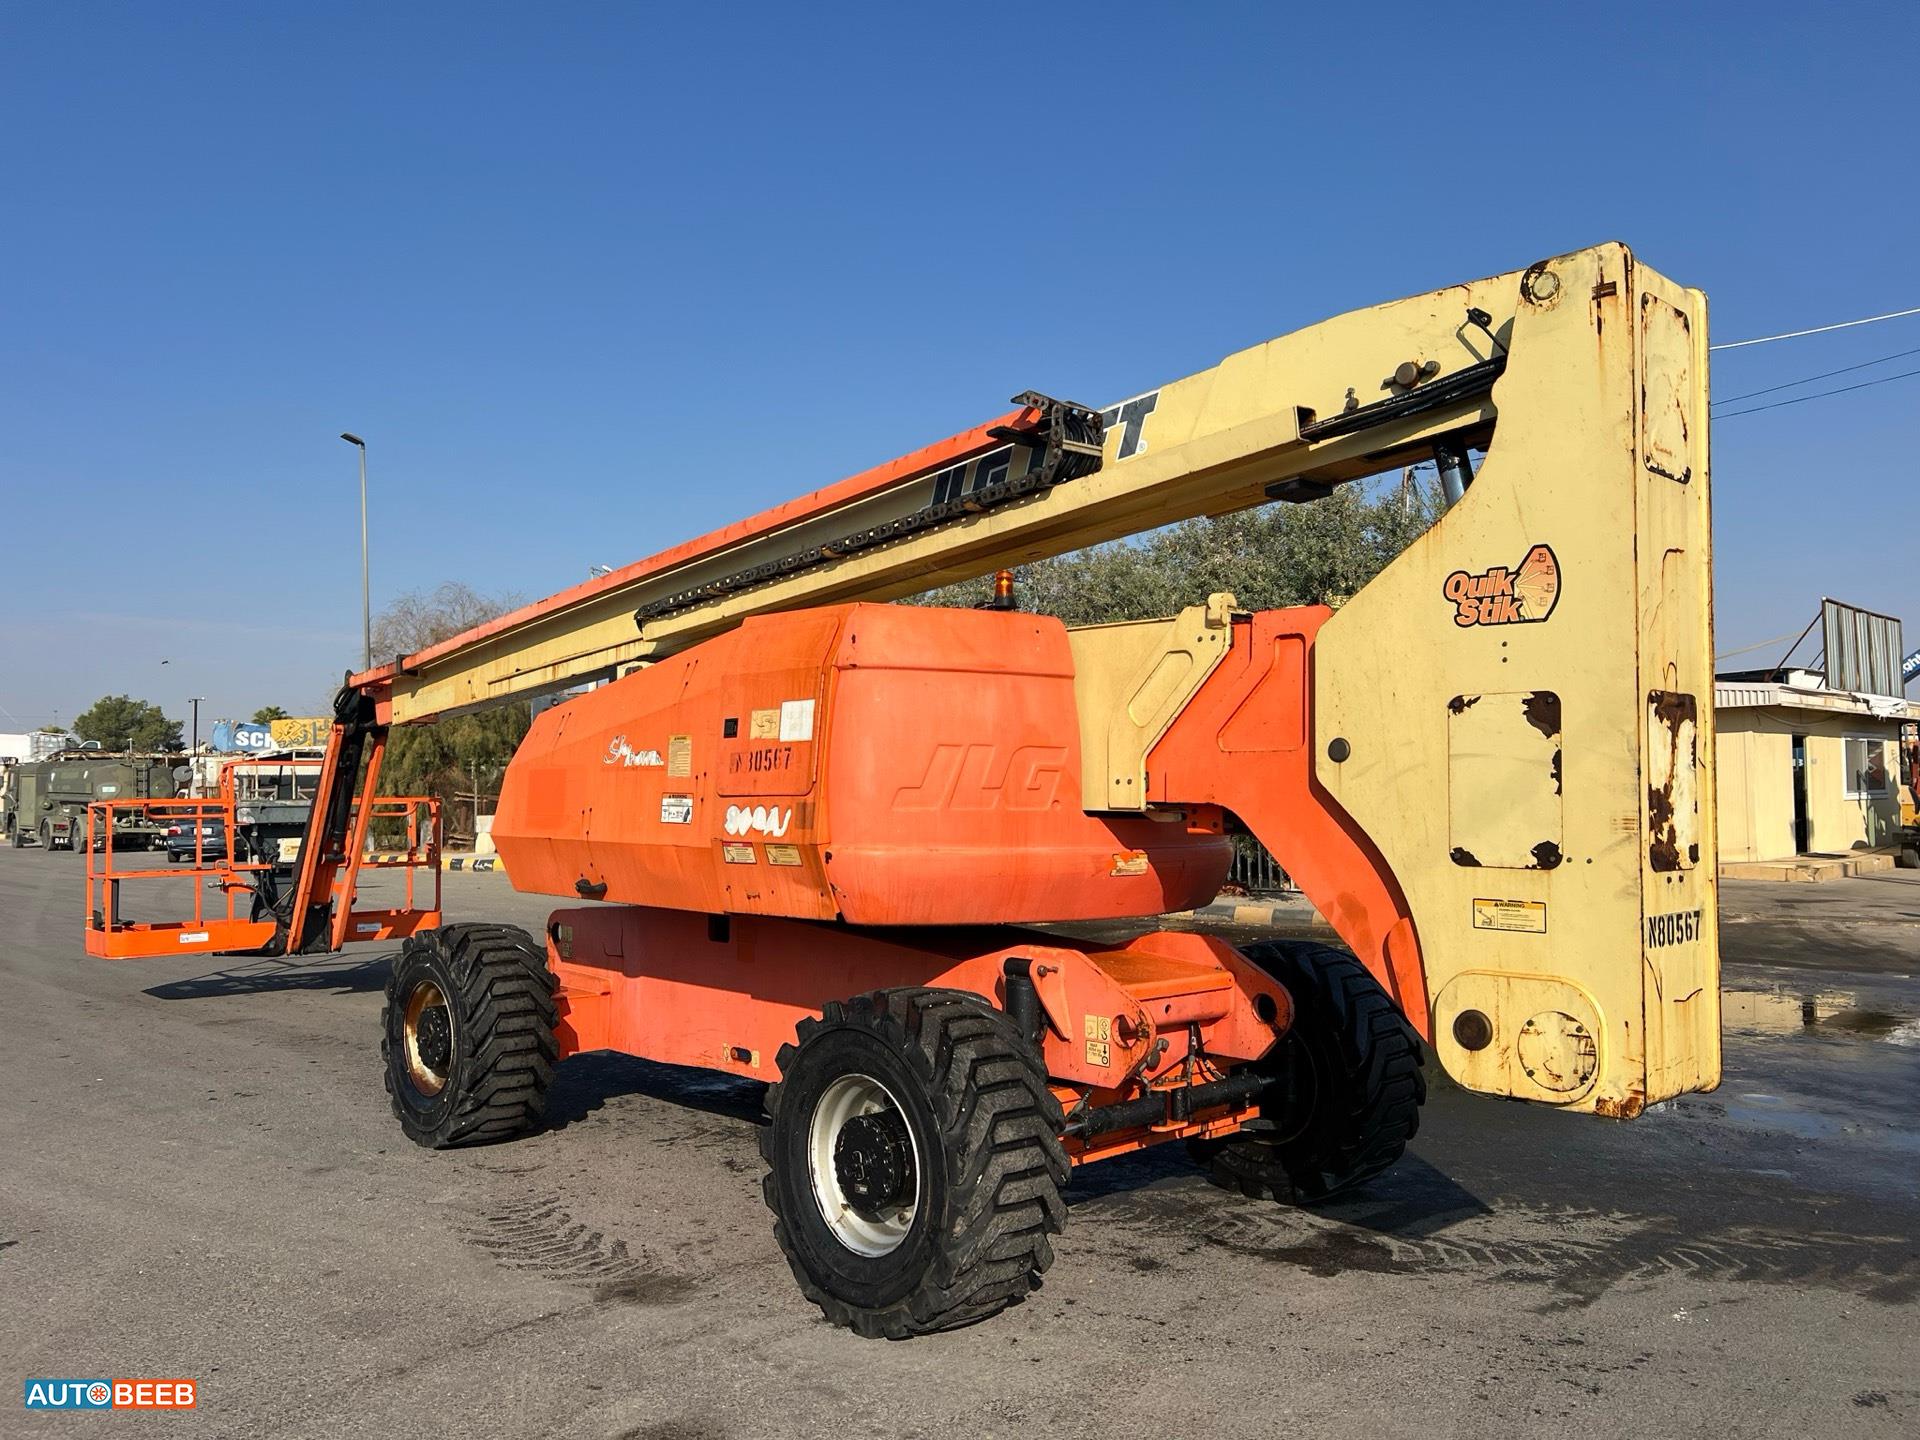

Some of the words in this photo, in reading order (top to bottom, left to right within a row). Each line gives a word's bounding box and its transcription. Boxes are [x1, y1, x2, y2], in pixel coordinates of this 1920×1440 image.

[1444, 568, 1519, 602] Quik
[1456, 596, 1522, 625] Stik
[891, 744, 1069, 811] JLG
[1648, 910, 1700, 948] N80567
